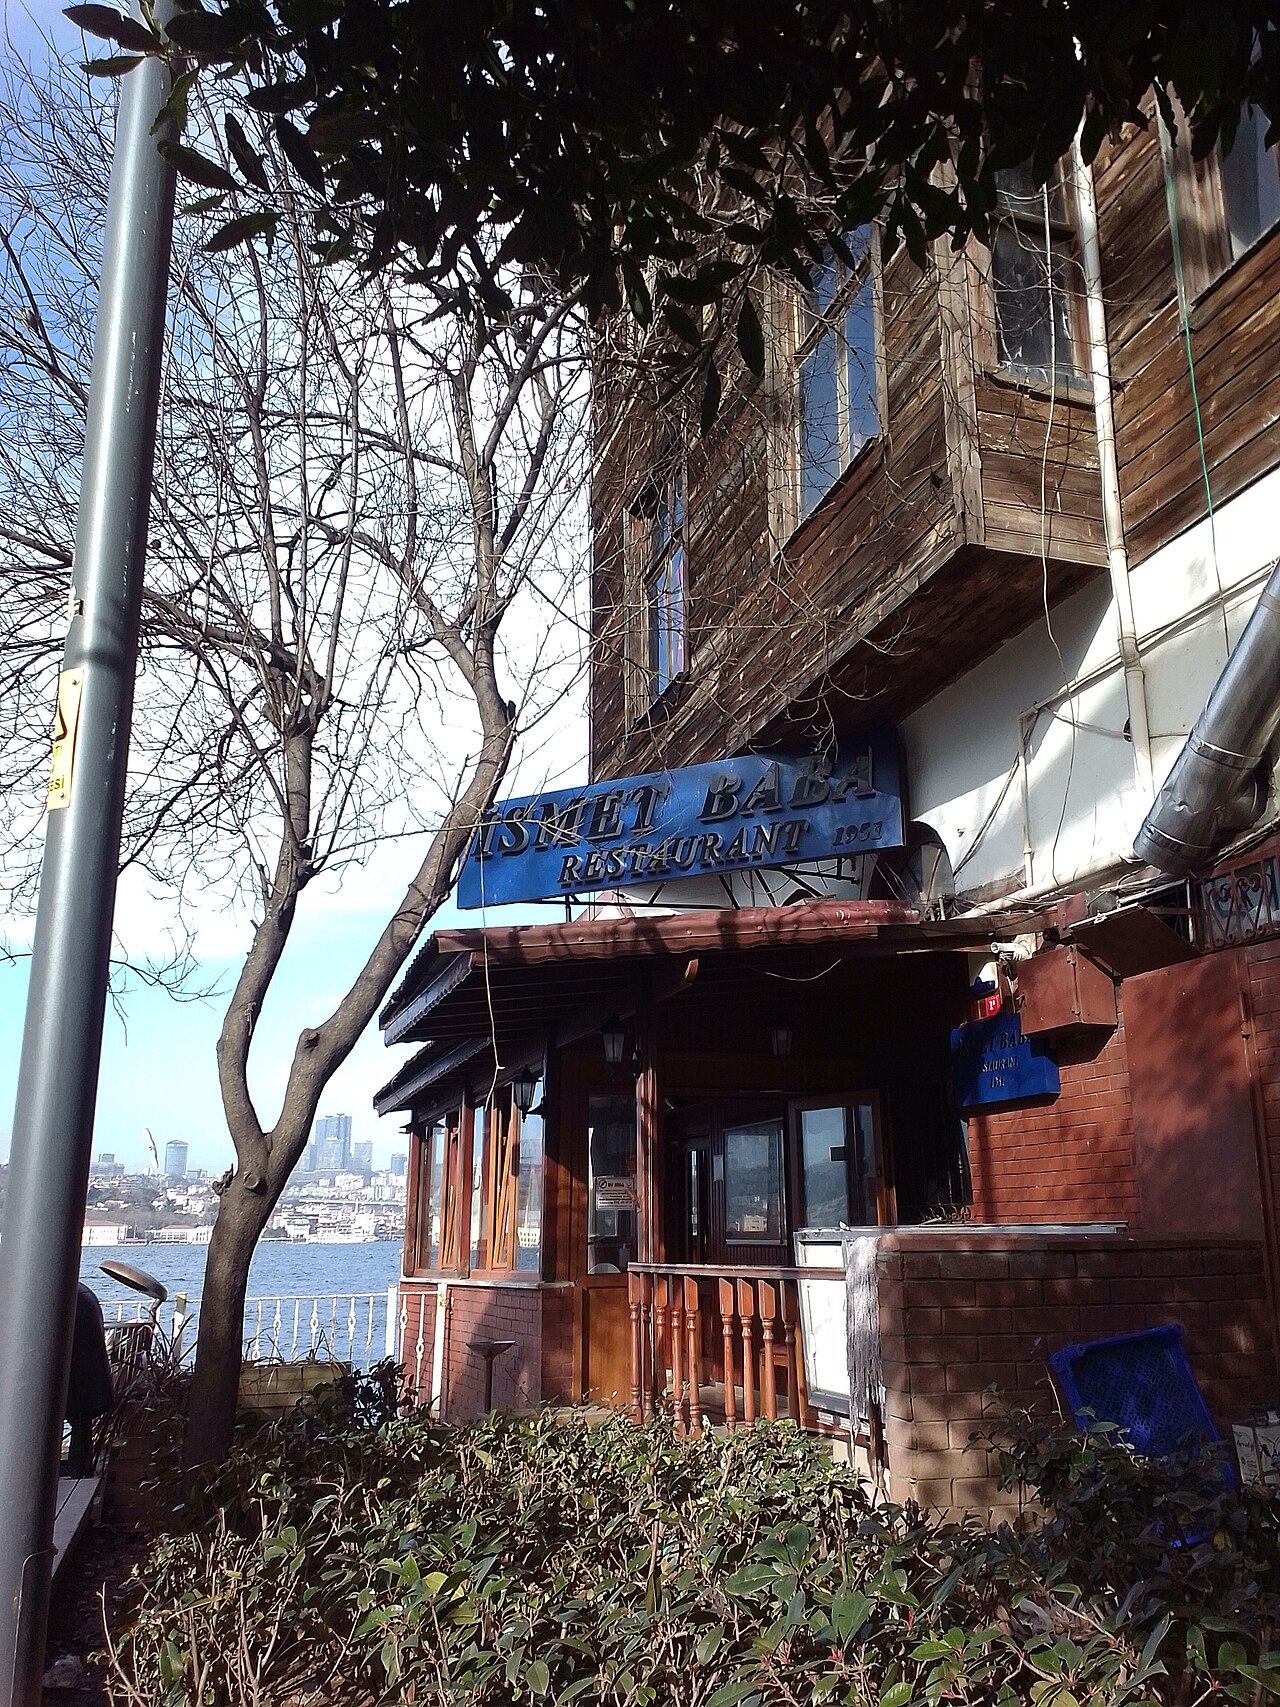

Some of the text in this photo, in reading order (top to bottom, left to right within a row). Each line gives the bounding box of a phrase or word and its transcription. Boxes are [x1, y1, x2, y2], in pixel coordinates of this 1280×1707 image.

[696, 744, 878, 824] BABA
[556, 817, 884, 887] RESTAURANT 1951
